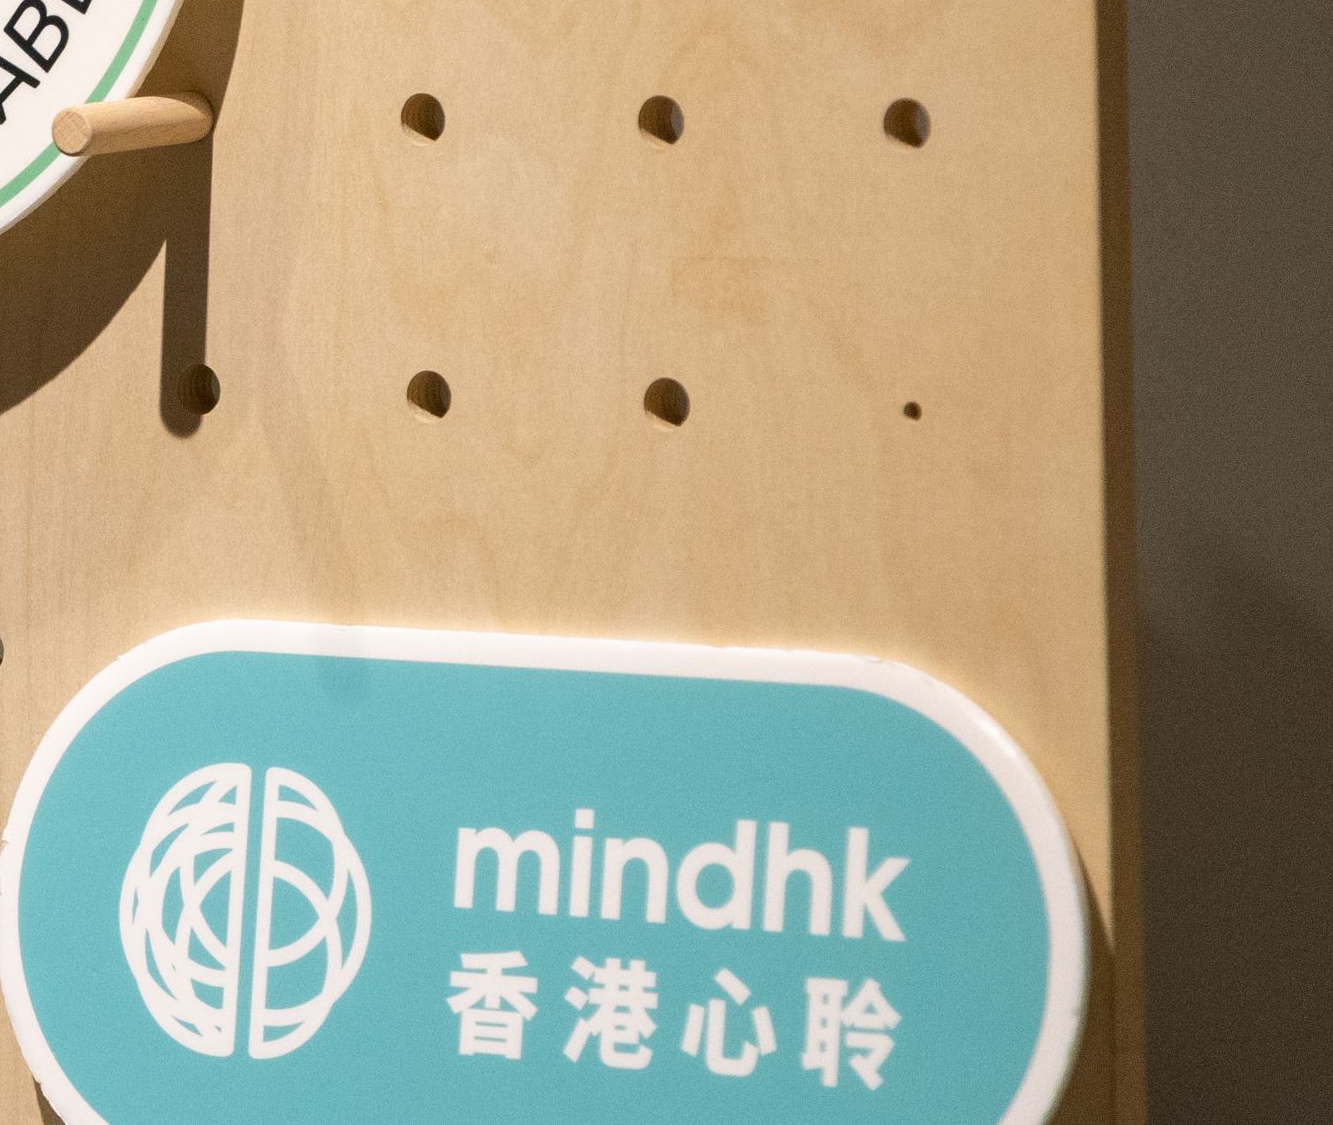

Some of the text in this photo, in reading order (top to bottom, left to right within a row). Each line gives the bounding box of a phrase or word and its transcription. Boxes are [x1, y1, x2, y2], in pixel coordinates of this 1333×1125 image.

[453, 807, 912, 942] mindhk
[447, 950, 904, 1092] 香港心聆
